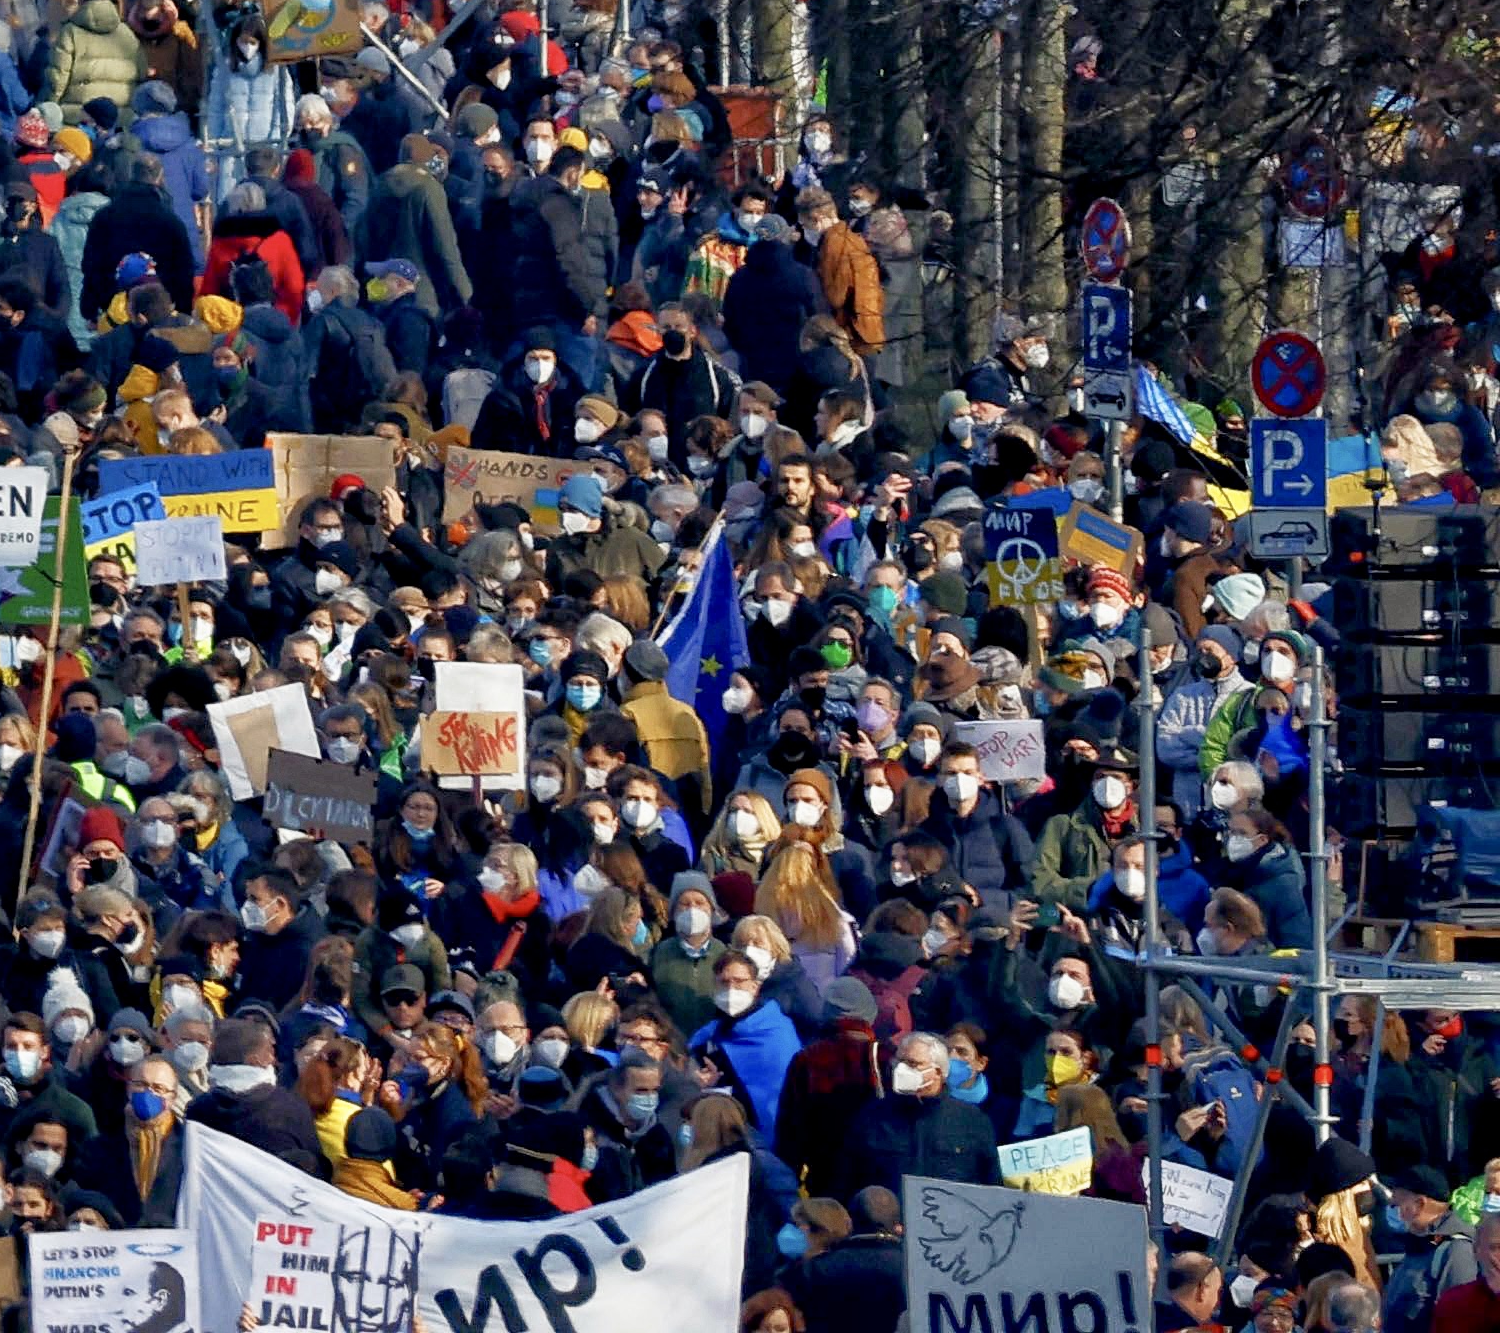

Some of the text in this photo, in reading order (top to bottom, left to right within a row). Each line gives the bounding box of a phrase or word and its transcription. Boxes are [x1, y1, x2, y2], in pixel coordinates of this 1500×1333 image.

[123, 457, 269, 487] STAND WITH
[478, 458, 548, 481] HANDS
[1263, 429, 1304, 497] P
[985, 511, 1033, 536] МИР
[0, 532, 34, 545] DEMO
[1001, 732, 1040, 768] WAR!
[1011, 1135, 1084, 1170] PEACE
[257, 1222, 314, 1247] PUT
[44, 1245, 117, 1261] LET'S STOP
[281, 1252, 329, 1273] HIM
[43, 1266, 120, 1280] FINANCING
[265, 1276, 297, 1295] IN
[433, 1216, 647, 1333] ир!
[44, 1285, 104, 1299] PUTIN'S
[259, 1300, 329, 1331] JAIL
